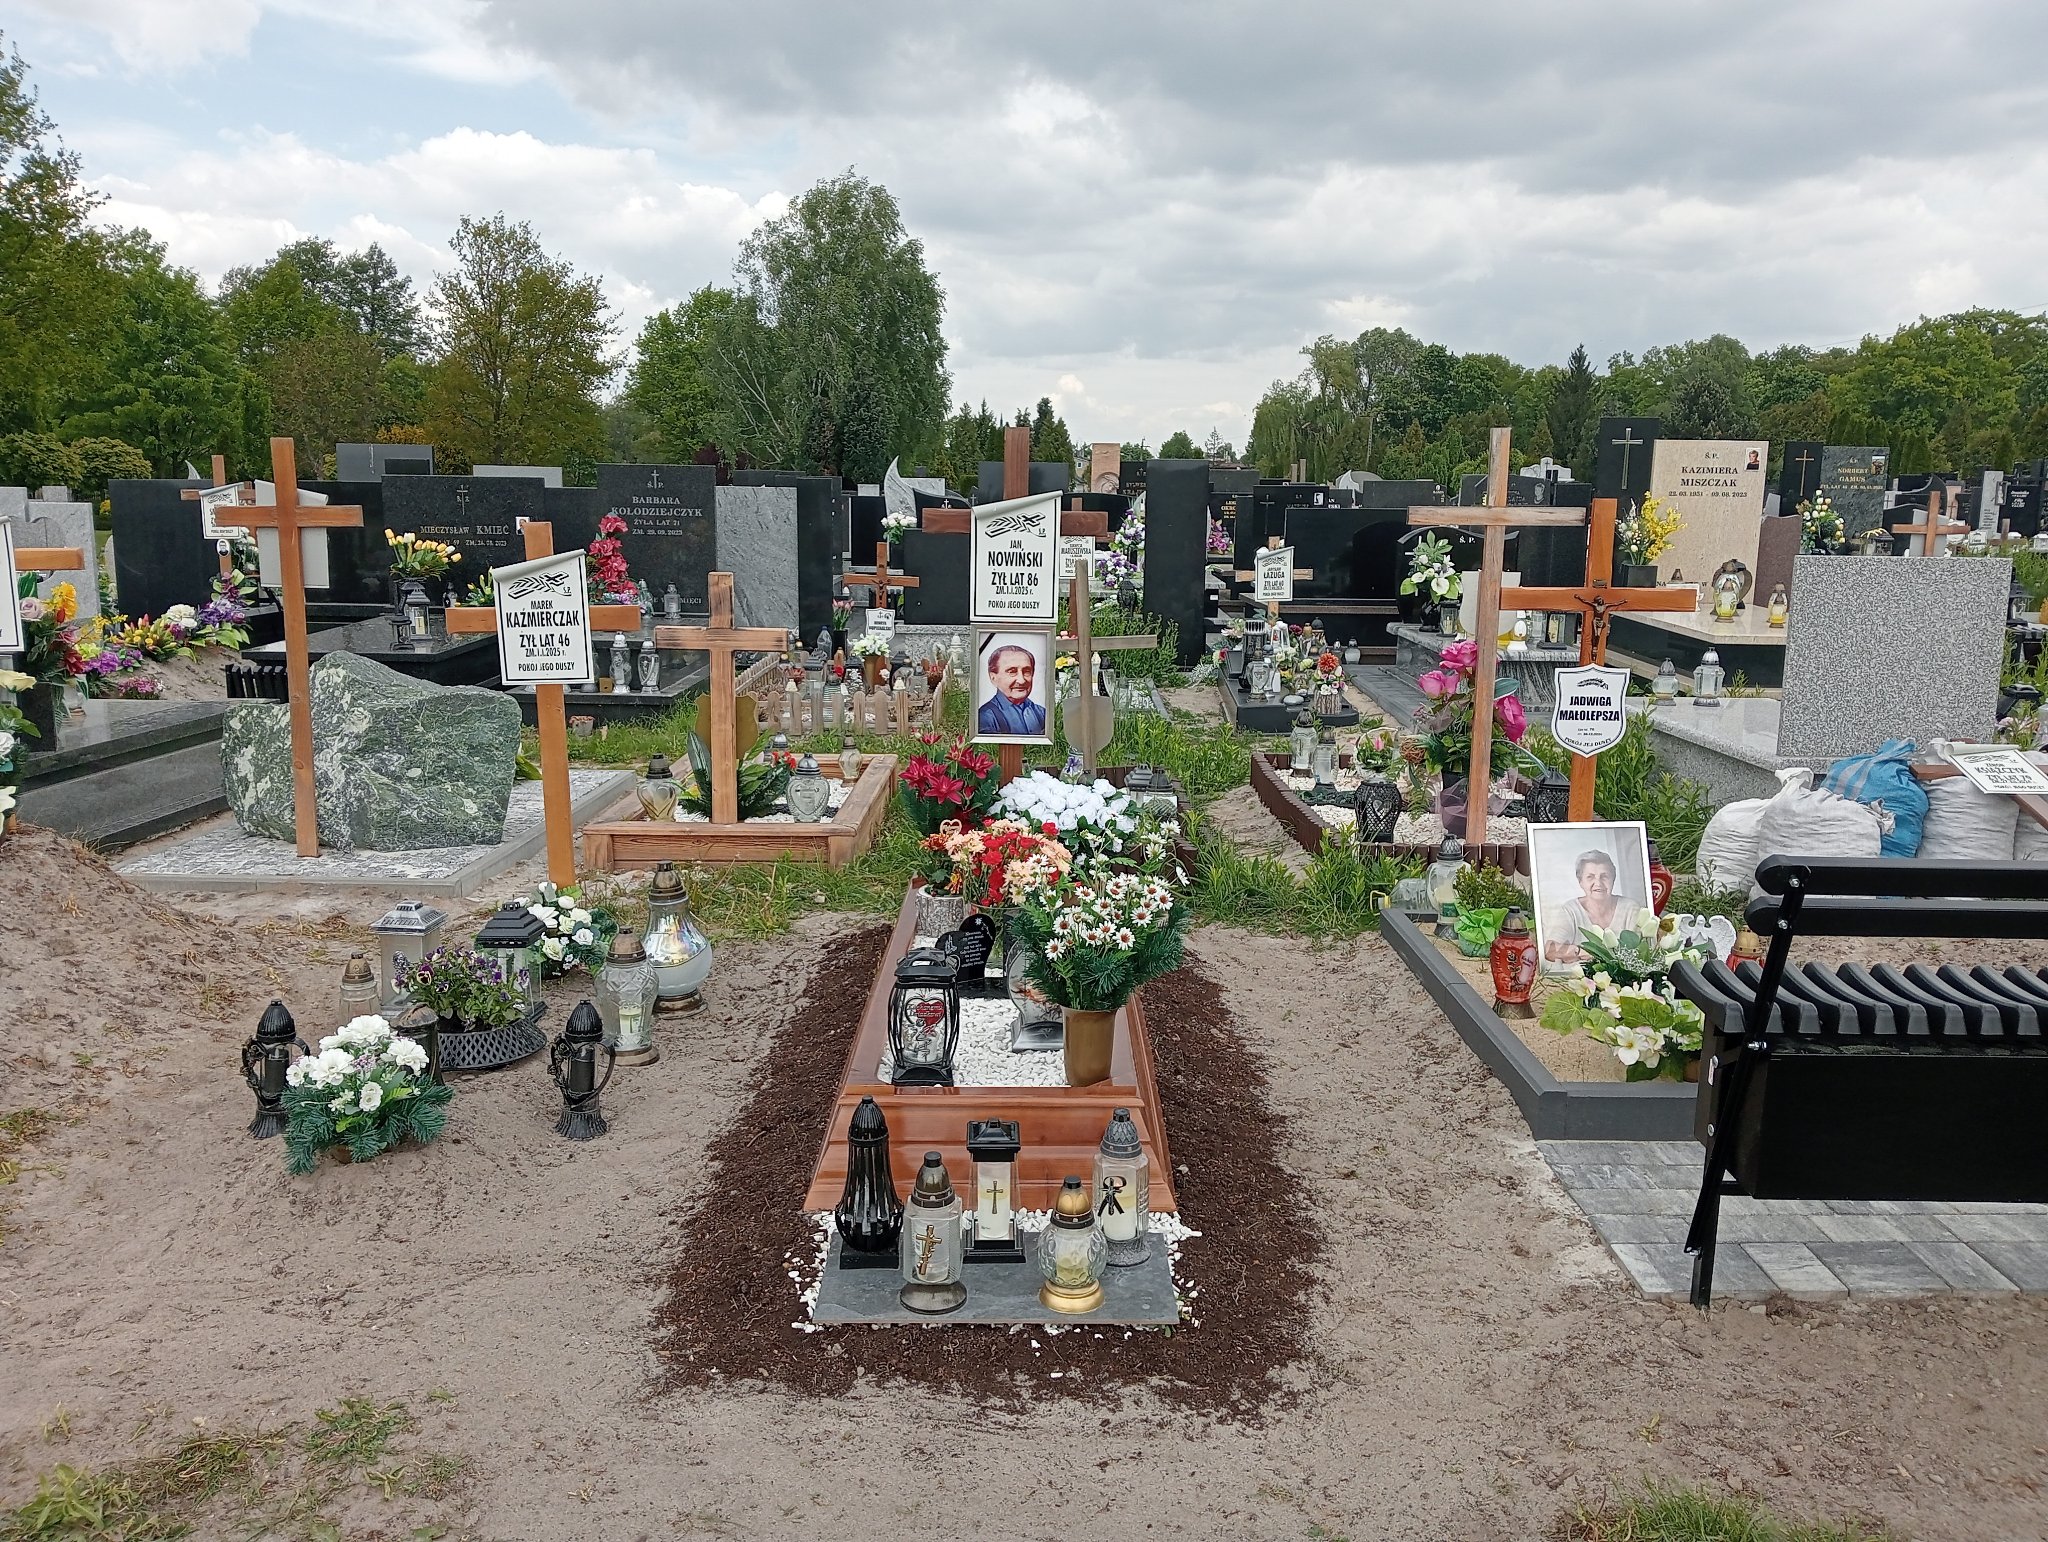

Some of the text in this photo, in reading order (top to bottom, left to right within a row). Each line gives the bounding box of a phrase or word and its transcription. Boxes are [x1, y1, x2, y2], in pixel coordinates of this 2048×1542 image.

[1681, 466, 1739, 474] KAZIMIERA
[1680, 478, 1738, 488] MISZCZAK
[632, 496, 681, 505] BARBARA
[612, 506, 703, 517] KOŁODZIEJCZYK
[420, 524, 510, 535] MIECZYSŁAW KMIEĆ
[1010, 540, 1022, 549] JAN
[988, 548, 1043, 568] NOWIŃSKI
[991, 568, 1038, 586] ŻYŁ LAT 86
[530, 600, 553, 610] MAREK
[988, 598, 1040, 609] POKÓJ JEGO DUSZY
[506, 608, 580, 628] KAŹMIERCZAK
[520, 630, 570, 648] ŻYŁ LAT 46
[518, 662, 575, 672] POKÓJ JEGO DUSZY
[1569, 696, 1612, 706] JADWIGA
[1559, 710, 1620, 722] MAŁOLEPSZA
